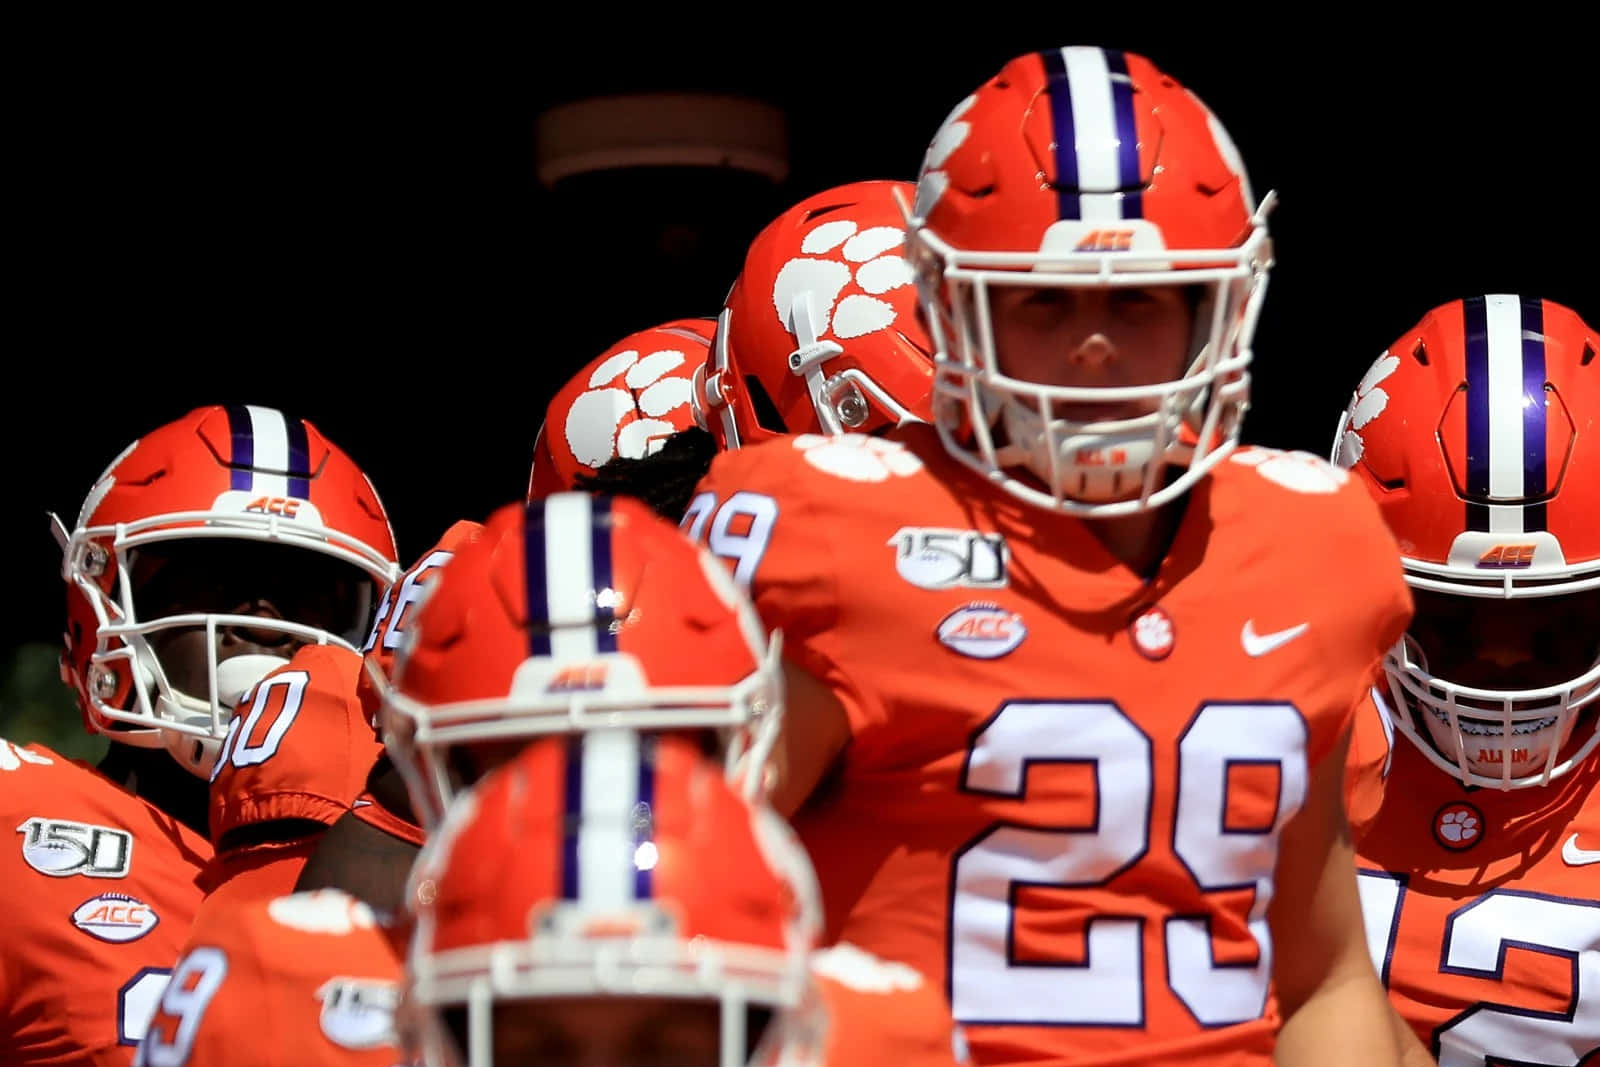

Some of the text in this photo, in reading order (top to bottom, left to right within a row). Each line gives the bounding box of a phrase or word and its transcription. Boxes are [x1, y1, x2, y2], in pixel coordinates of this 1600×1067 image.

[241, 496, 299, 519] ACC
[888, 526, 1011, 591] 150
[949, 616, 1012, 640] ACC
[210, 670, 310, 784] 0
[16, 816, 134, 879] 150
[948, 698, 1308, 1030] 29
[85, 906, 147, 928] ACC
